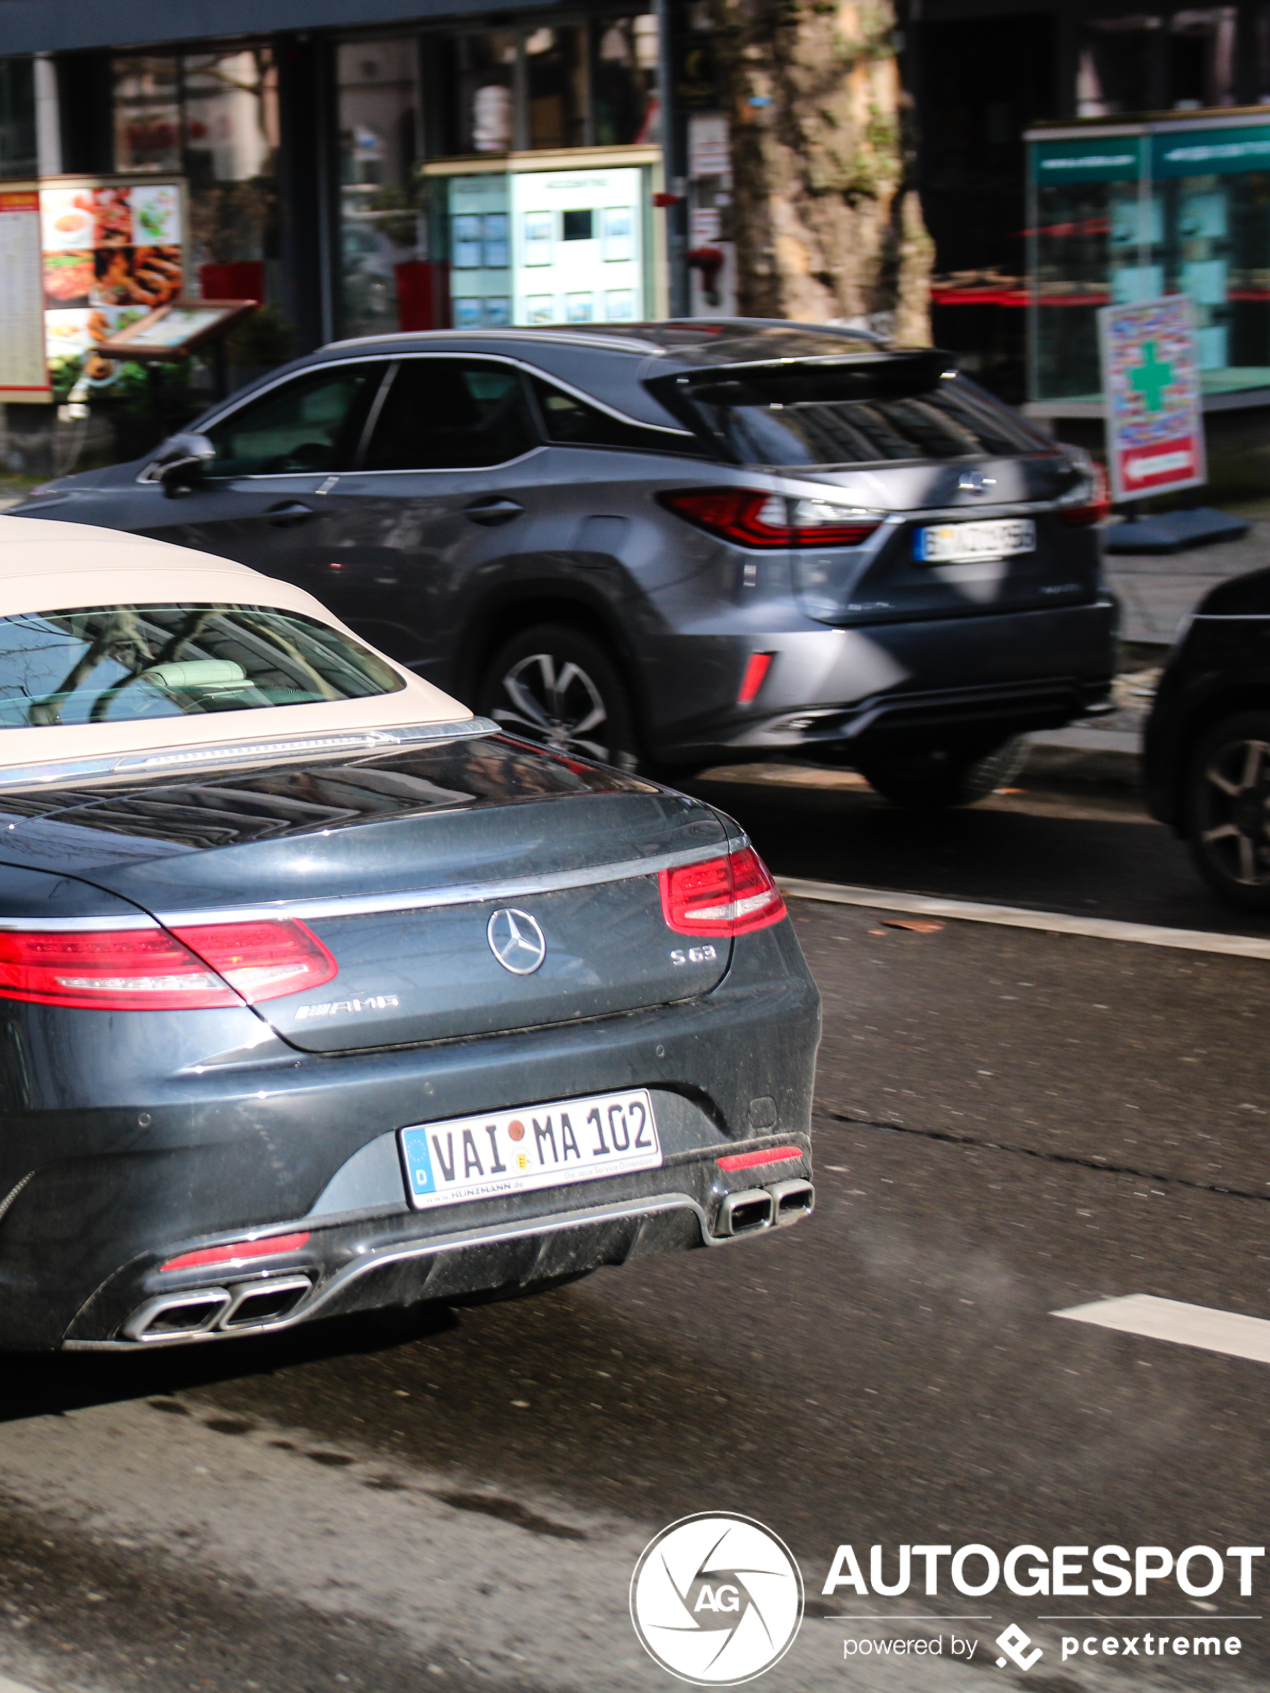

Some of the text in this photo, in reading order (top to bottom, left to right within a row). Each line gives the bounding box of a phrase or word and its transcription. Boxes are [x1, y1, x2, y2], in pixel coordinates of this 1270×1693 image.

[670, 945, 717, 966] S 63
[431, 1101, 652, 1181] VAI MA 102
[416, 1169, 428, 1185] D
